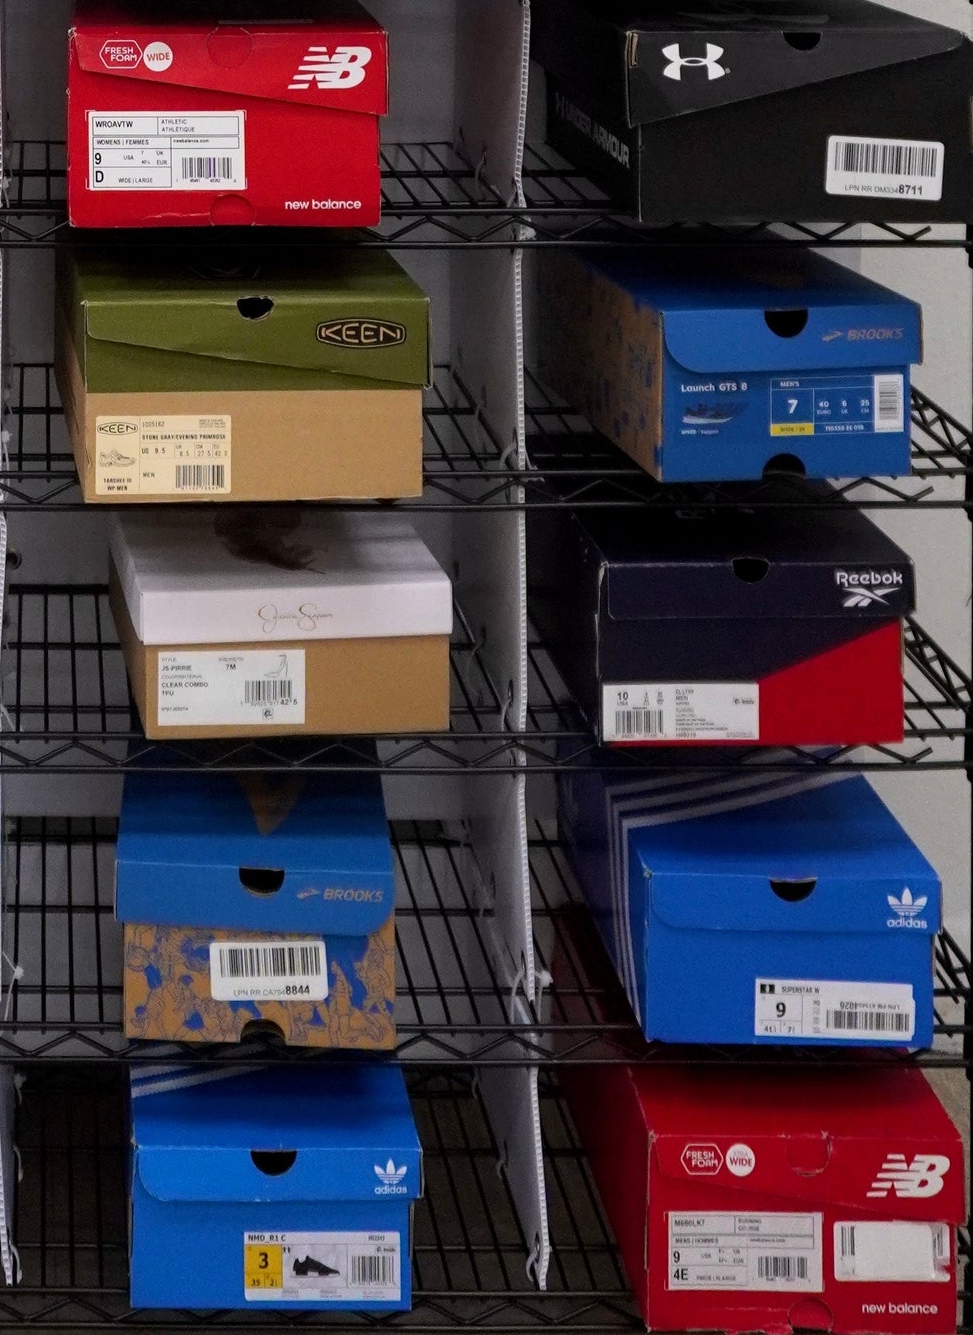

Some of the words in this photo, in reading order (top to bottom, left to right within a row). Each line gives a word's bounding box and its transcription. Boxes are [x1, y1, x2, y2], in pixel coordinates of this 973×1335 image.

[105, 47, 134, 55] FRESH
[111, 53, 138, 62] FOAM
[147, 52, 170, 62] WIDE
[288, 46, 372, 89] NB
[95, 120, 134, 129] WROAVTW
[94, 152, 102, 165] 9
[95, 171, 104, 183] D
[899, 184, 922, 195] 8711
[285, 200, 310, 210] new
[312, 199, 362, 210] balance
[320, 323, 401, 343] KEEN
[847, 327, 904, 341] BROOKS
[681, 383, 715, 393] Launch
[719, 382, 737, 392] GTS
[787, 399, 798, 414] 7
[99, 424, 136, 433] KEEN
[835, 571, 903, 587] Reebok
[161, 681, 183, 689] CLEAR
[617, 692, 628, 700] 10
[323, 888, 384, 903] BROOKS
[887, 917, 928, 930] adidas
[286, 985, 310, 995] 8844
[781, 986, 813, 994] SUPERSTAR
[776, 1002, 786, 1017] 9
[686, 1151, 715, 1160] FRESH
[691, 1158, 718, 1167] FOAM
[730, 1157, 753, 1168] WIDE
[866, 1154, 950, 1198] NB
[374, 1185, 407, 1194] adidas
[258, 1252, 269, 1269] 3
[674, 1251, 680, 1263] 9
[674, 1268, 689, 1280] 4E
[862, 1303, 887, 1315] new
[889, 1302, 938, 1315] balance
